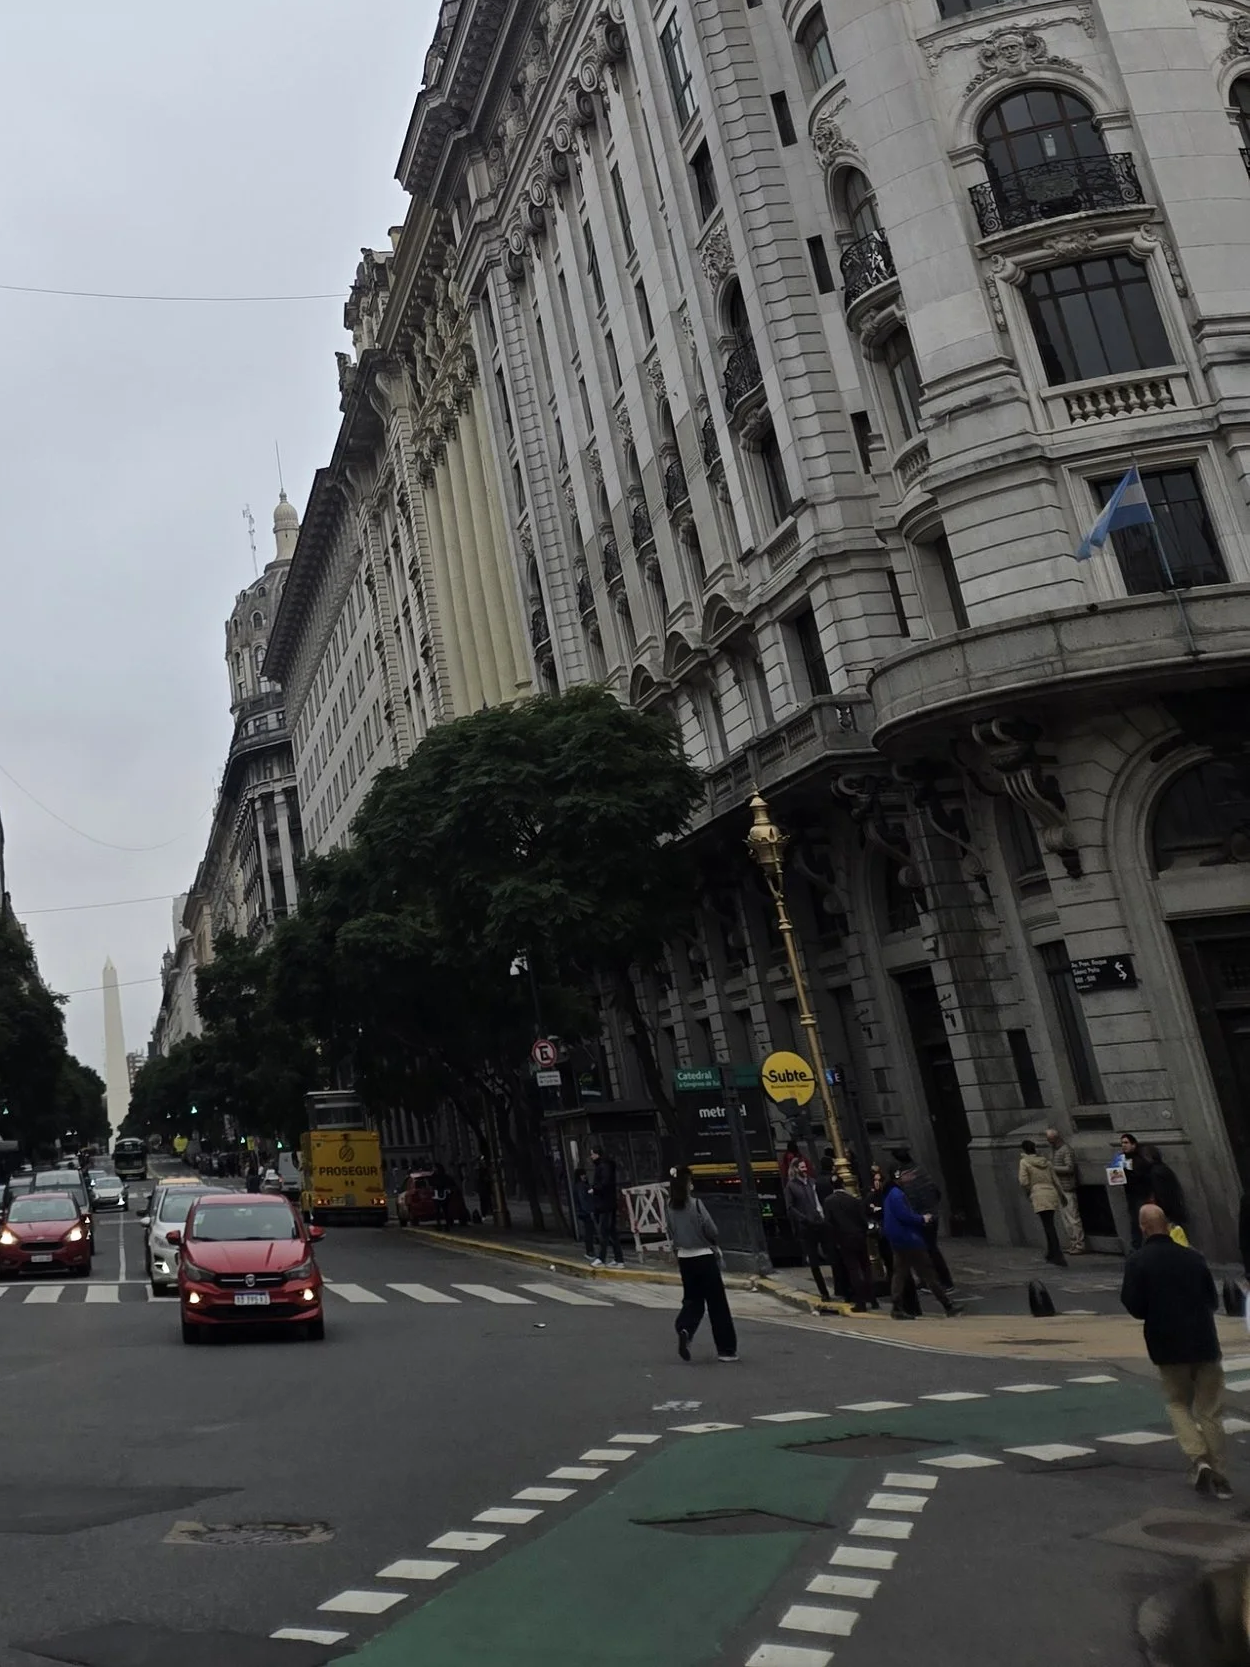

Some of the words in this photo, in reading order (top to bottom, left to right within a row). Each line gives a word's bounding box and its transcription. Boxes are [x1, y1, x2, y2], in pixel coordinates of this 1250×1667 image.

[677, 1070, 713, 1082] Catedral
[765, 1068, 812, 1084] Subte
[319, 1166, 378, 1176] PROSEGUR
